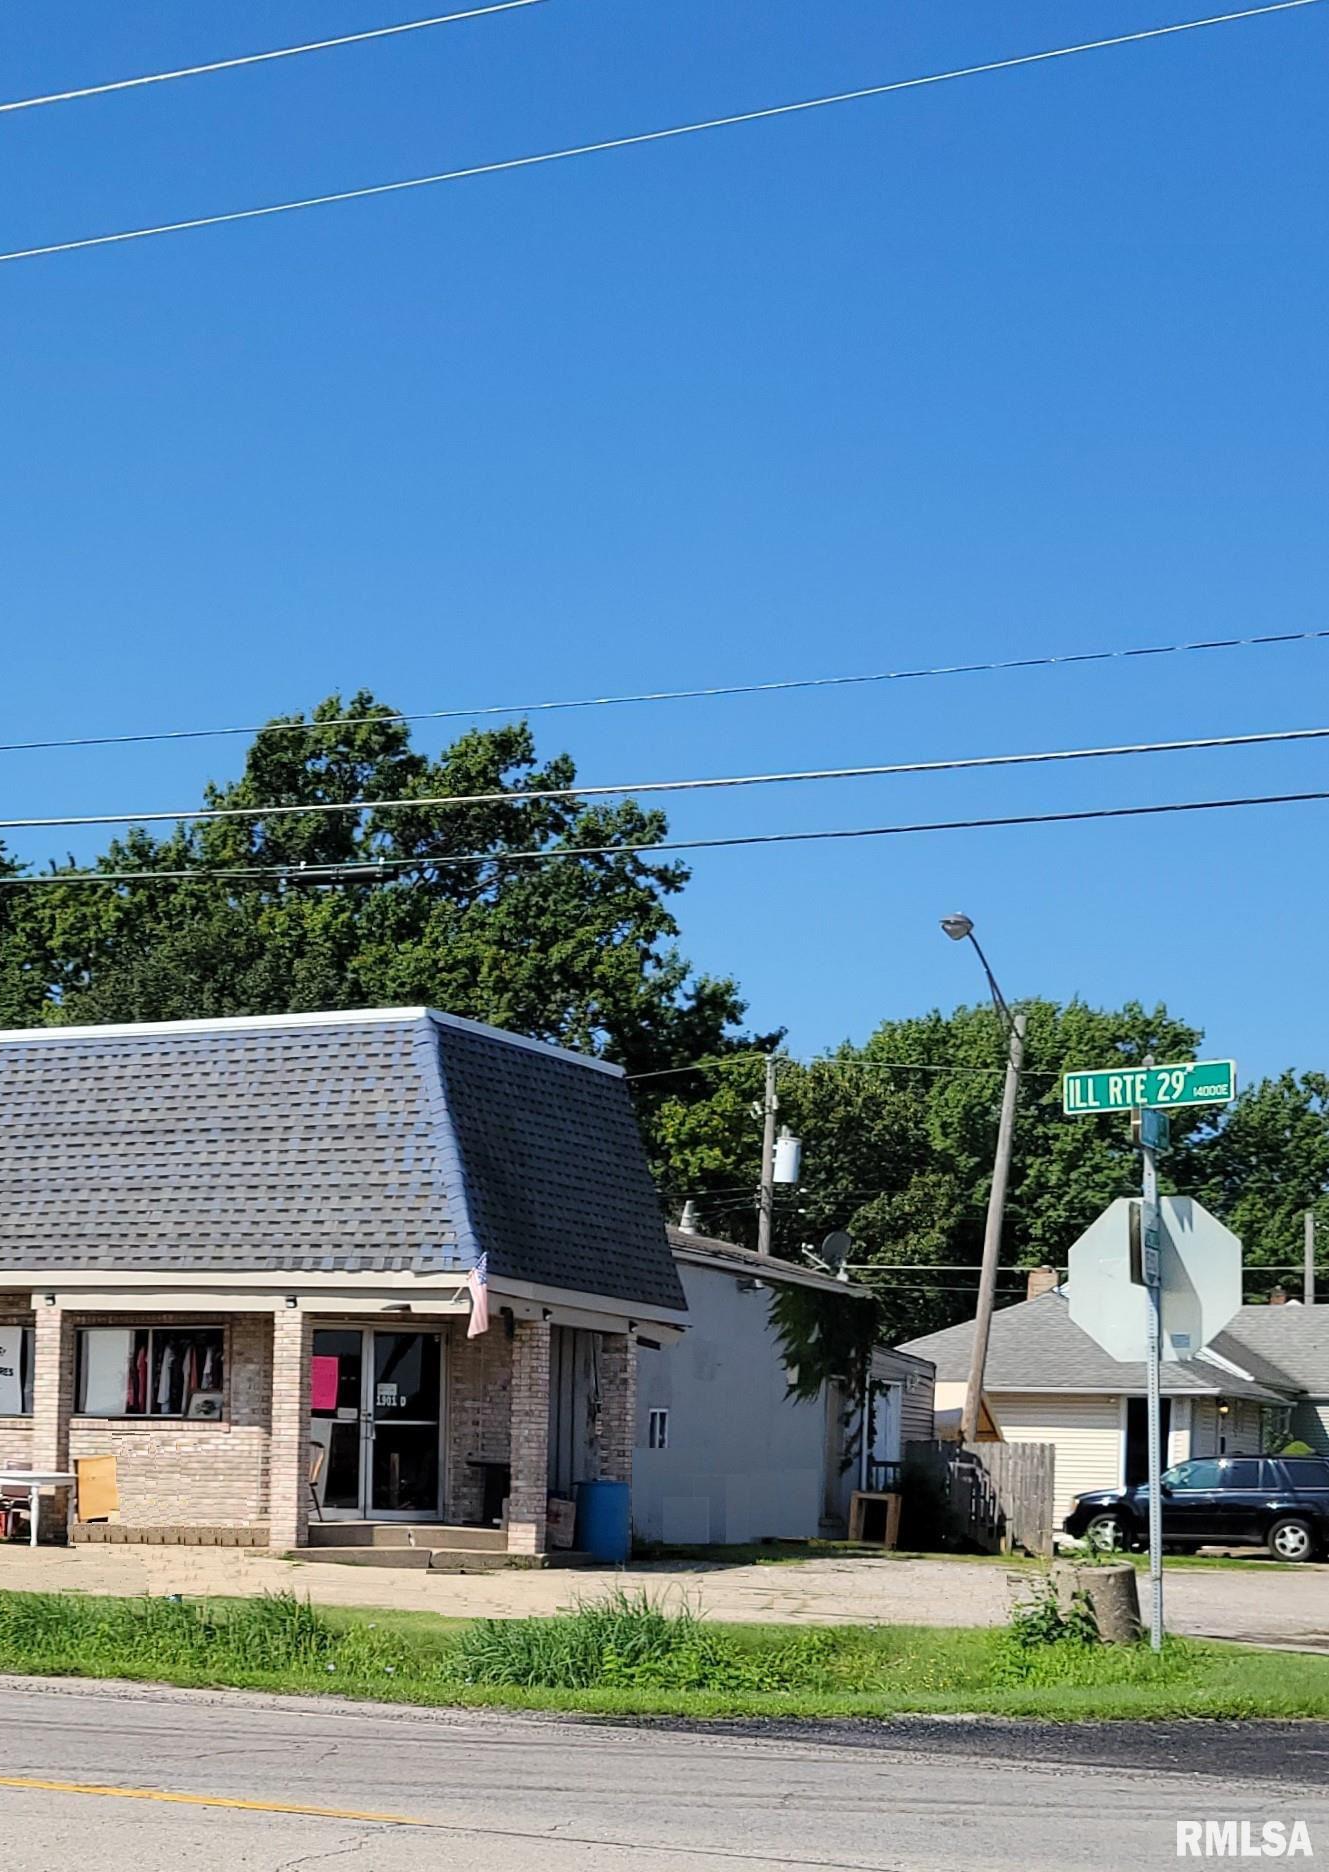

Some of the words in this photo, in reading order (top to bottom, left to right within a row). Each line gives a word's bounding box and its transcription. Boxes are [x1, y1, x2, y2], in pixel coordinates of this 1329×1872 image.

[1069, 1077, 1100, 1108] ILL
[1109, 1073, 1148, 1106] RTE
[1157, 1070, 1186, 1102] 29
[375, 1395, 398, 1407] 1901
